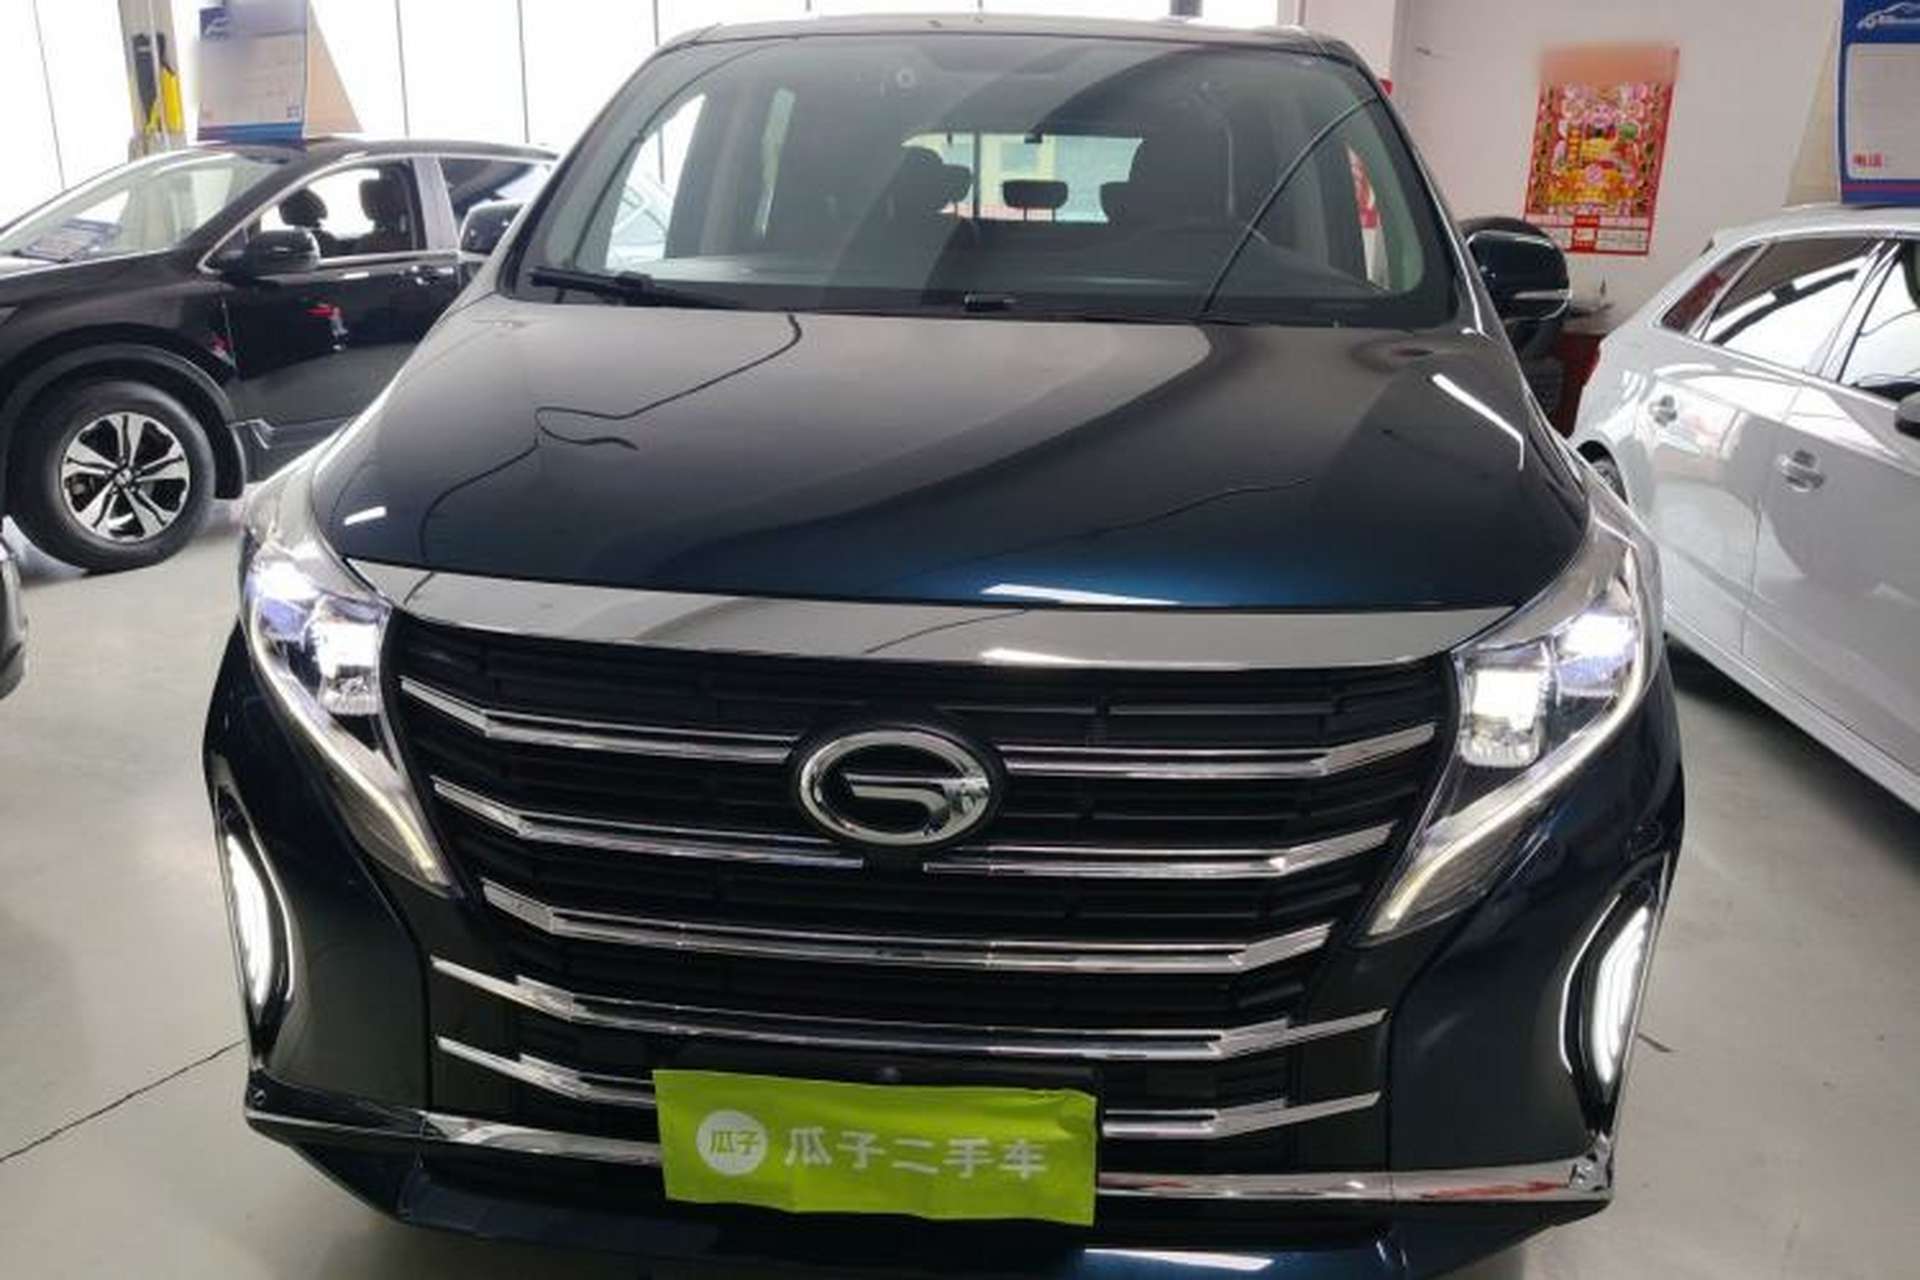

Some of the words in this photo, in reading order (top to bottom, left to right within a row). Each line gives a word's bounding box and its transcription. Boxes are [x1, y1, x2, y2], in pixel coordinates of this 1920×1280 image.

[709, 1130, 759, 1156] 瓜子
[783, 1126, 1047, 1181] 瓜子二手车
